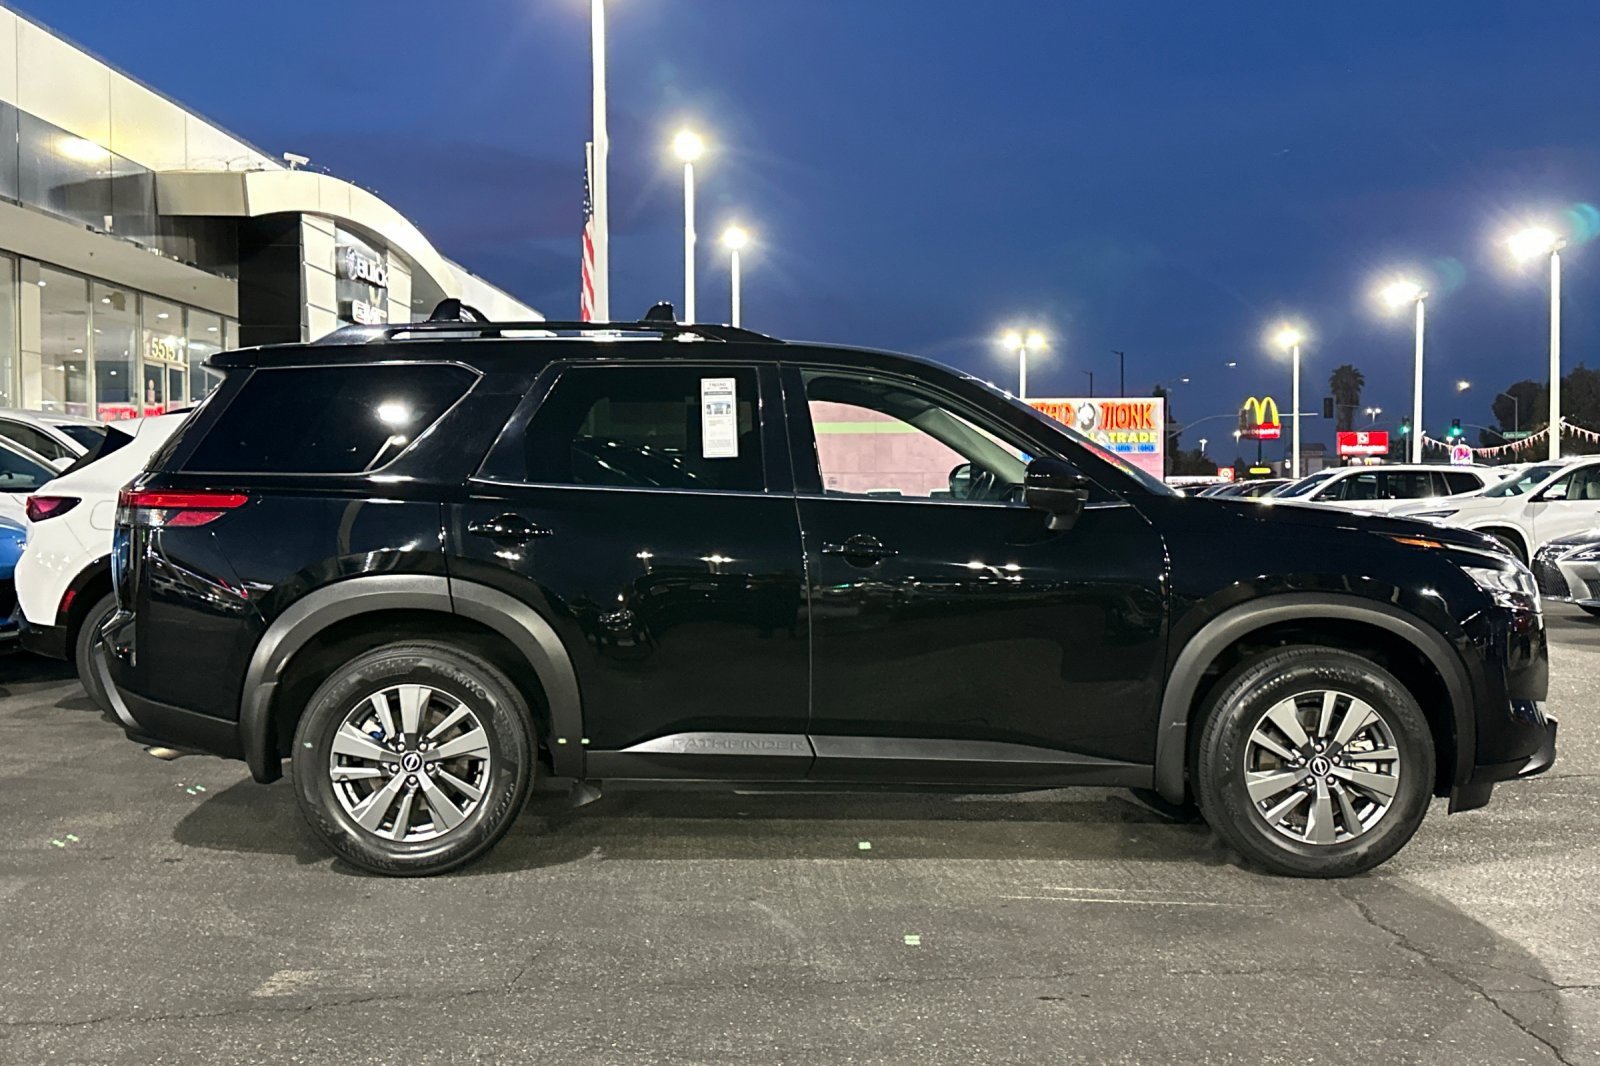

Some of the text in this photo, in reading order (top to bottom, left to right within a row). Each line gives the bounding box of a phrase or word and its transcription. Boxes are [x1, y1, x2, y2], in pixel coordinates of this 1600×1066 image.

[356, 257, 389, 288] BUICK
[151, 337, 176, 361] 5515
[1097, 401, 1155, 431] MONK
[1108, 431, 1158, 443] TRADE
[672, 737, 805, 751] PATHFINDER
